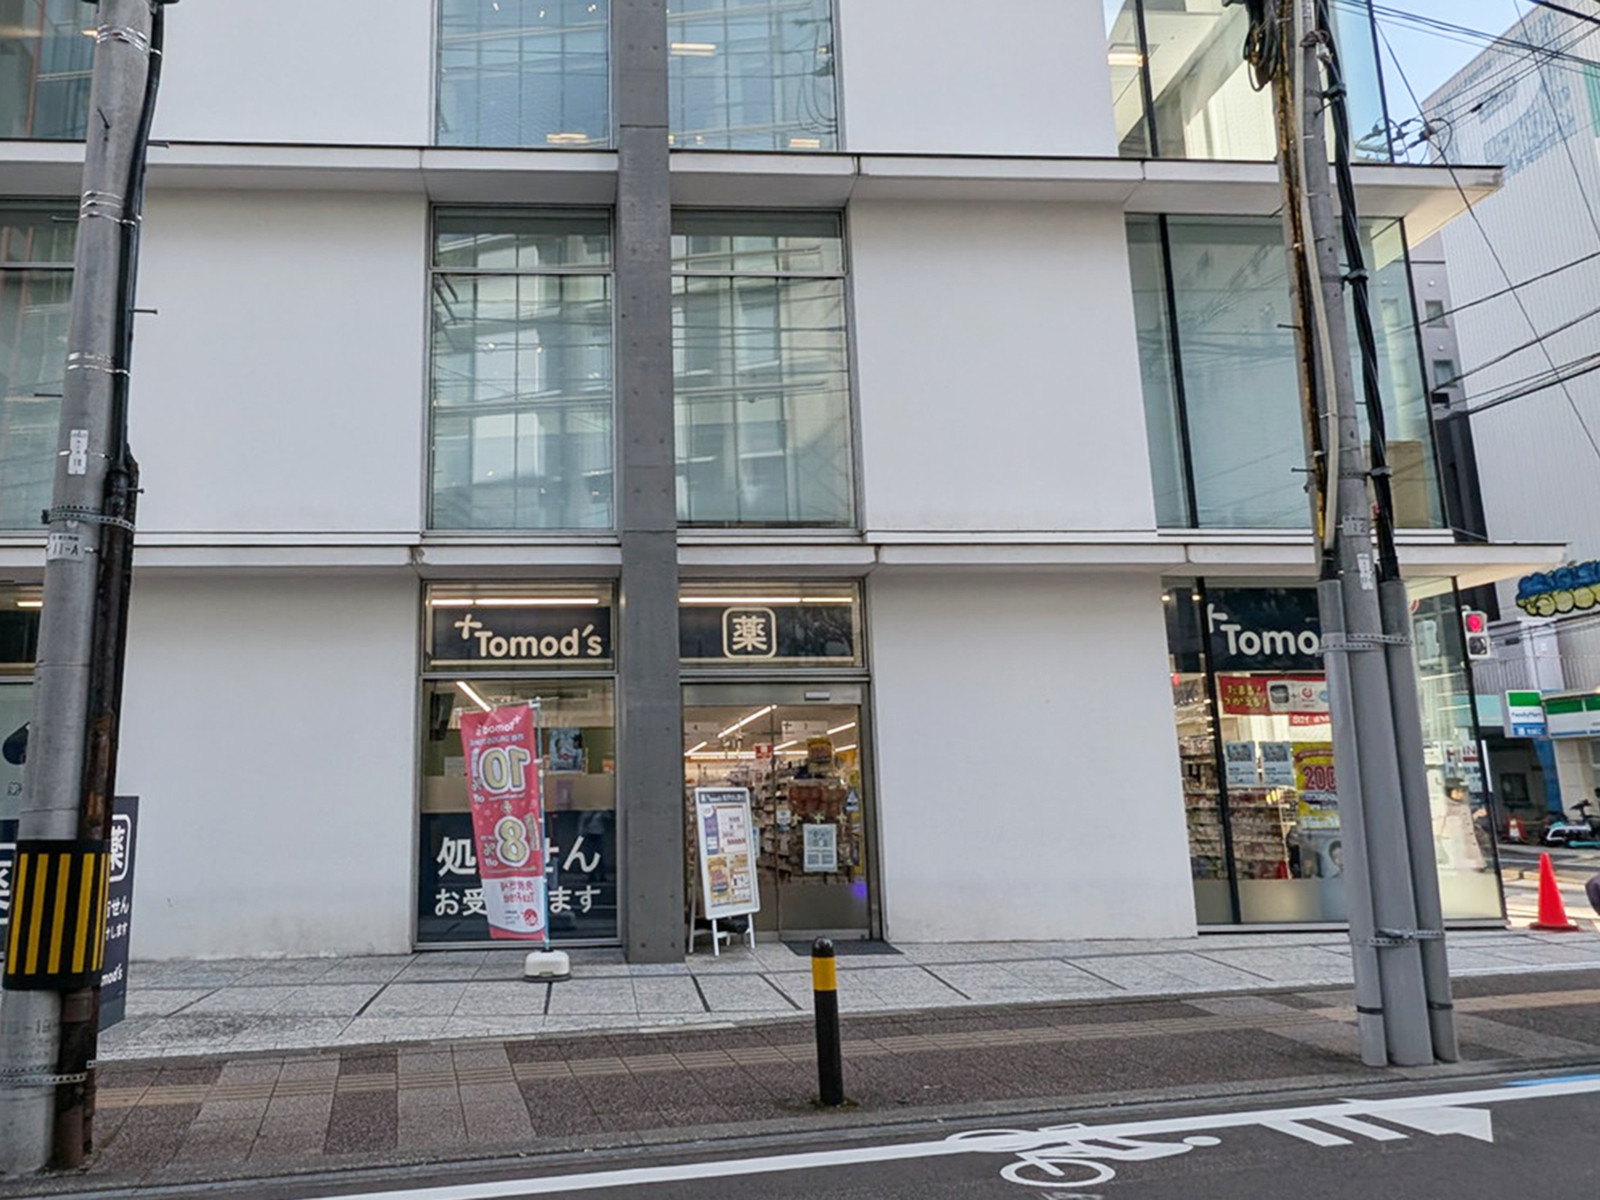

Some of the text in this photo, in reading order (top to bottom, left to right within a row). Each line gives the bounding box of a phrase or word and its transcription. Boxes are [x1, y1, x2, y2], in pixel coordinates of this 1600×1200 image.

[474, 624, 603, 657] Tomod's
[732, 615, 768, 651] 薬
[1220, 624, 1320, 656] Tomo
[435, 885, 601, 917] お受ます
[101, 963, 123, 986] mod's
